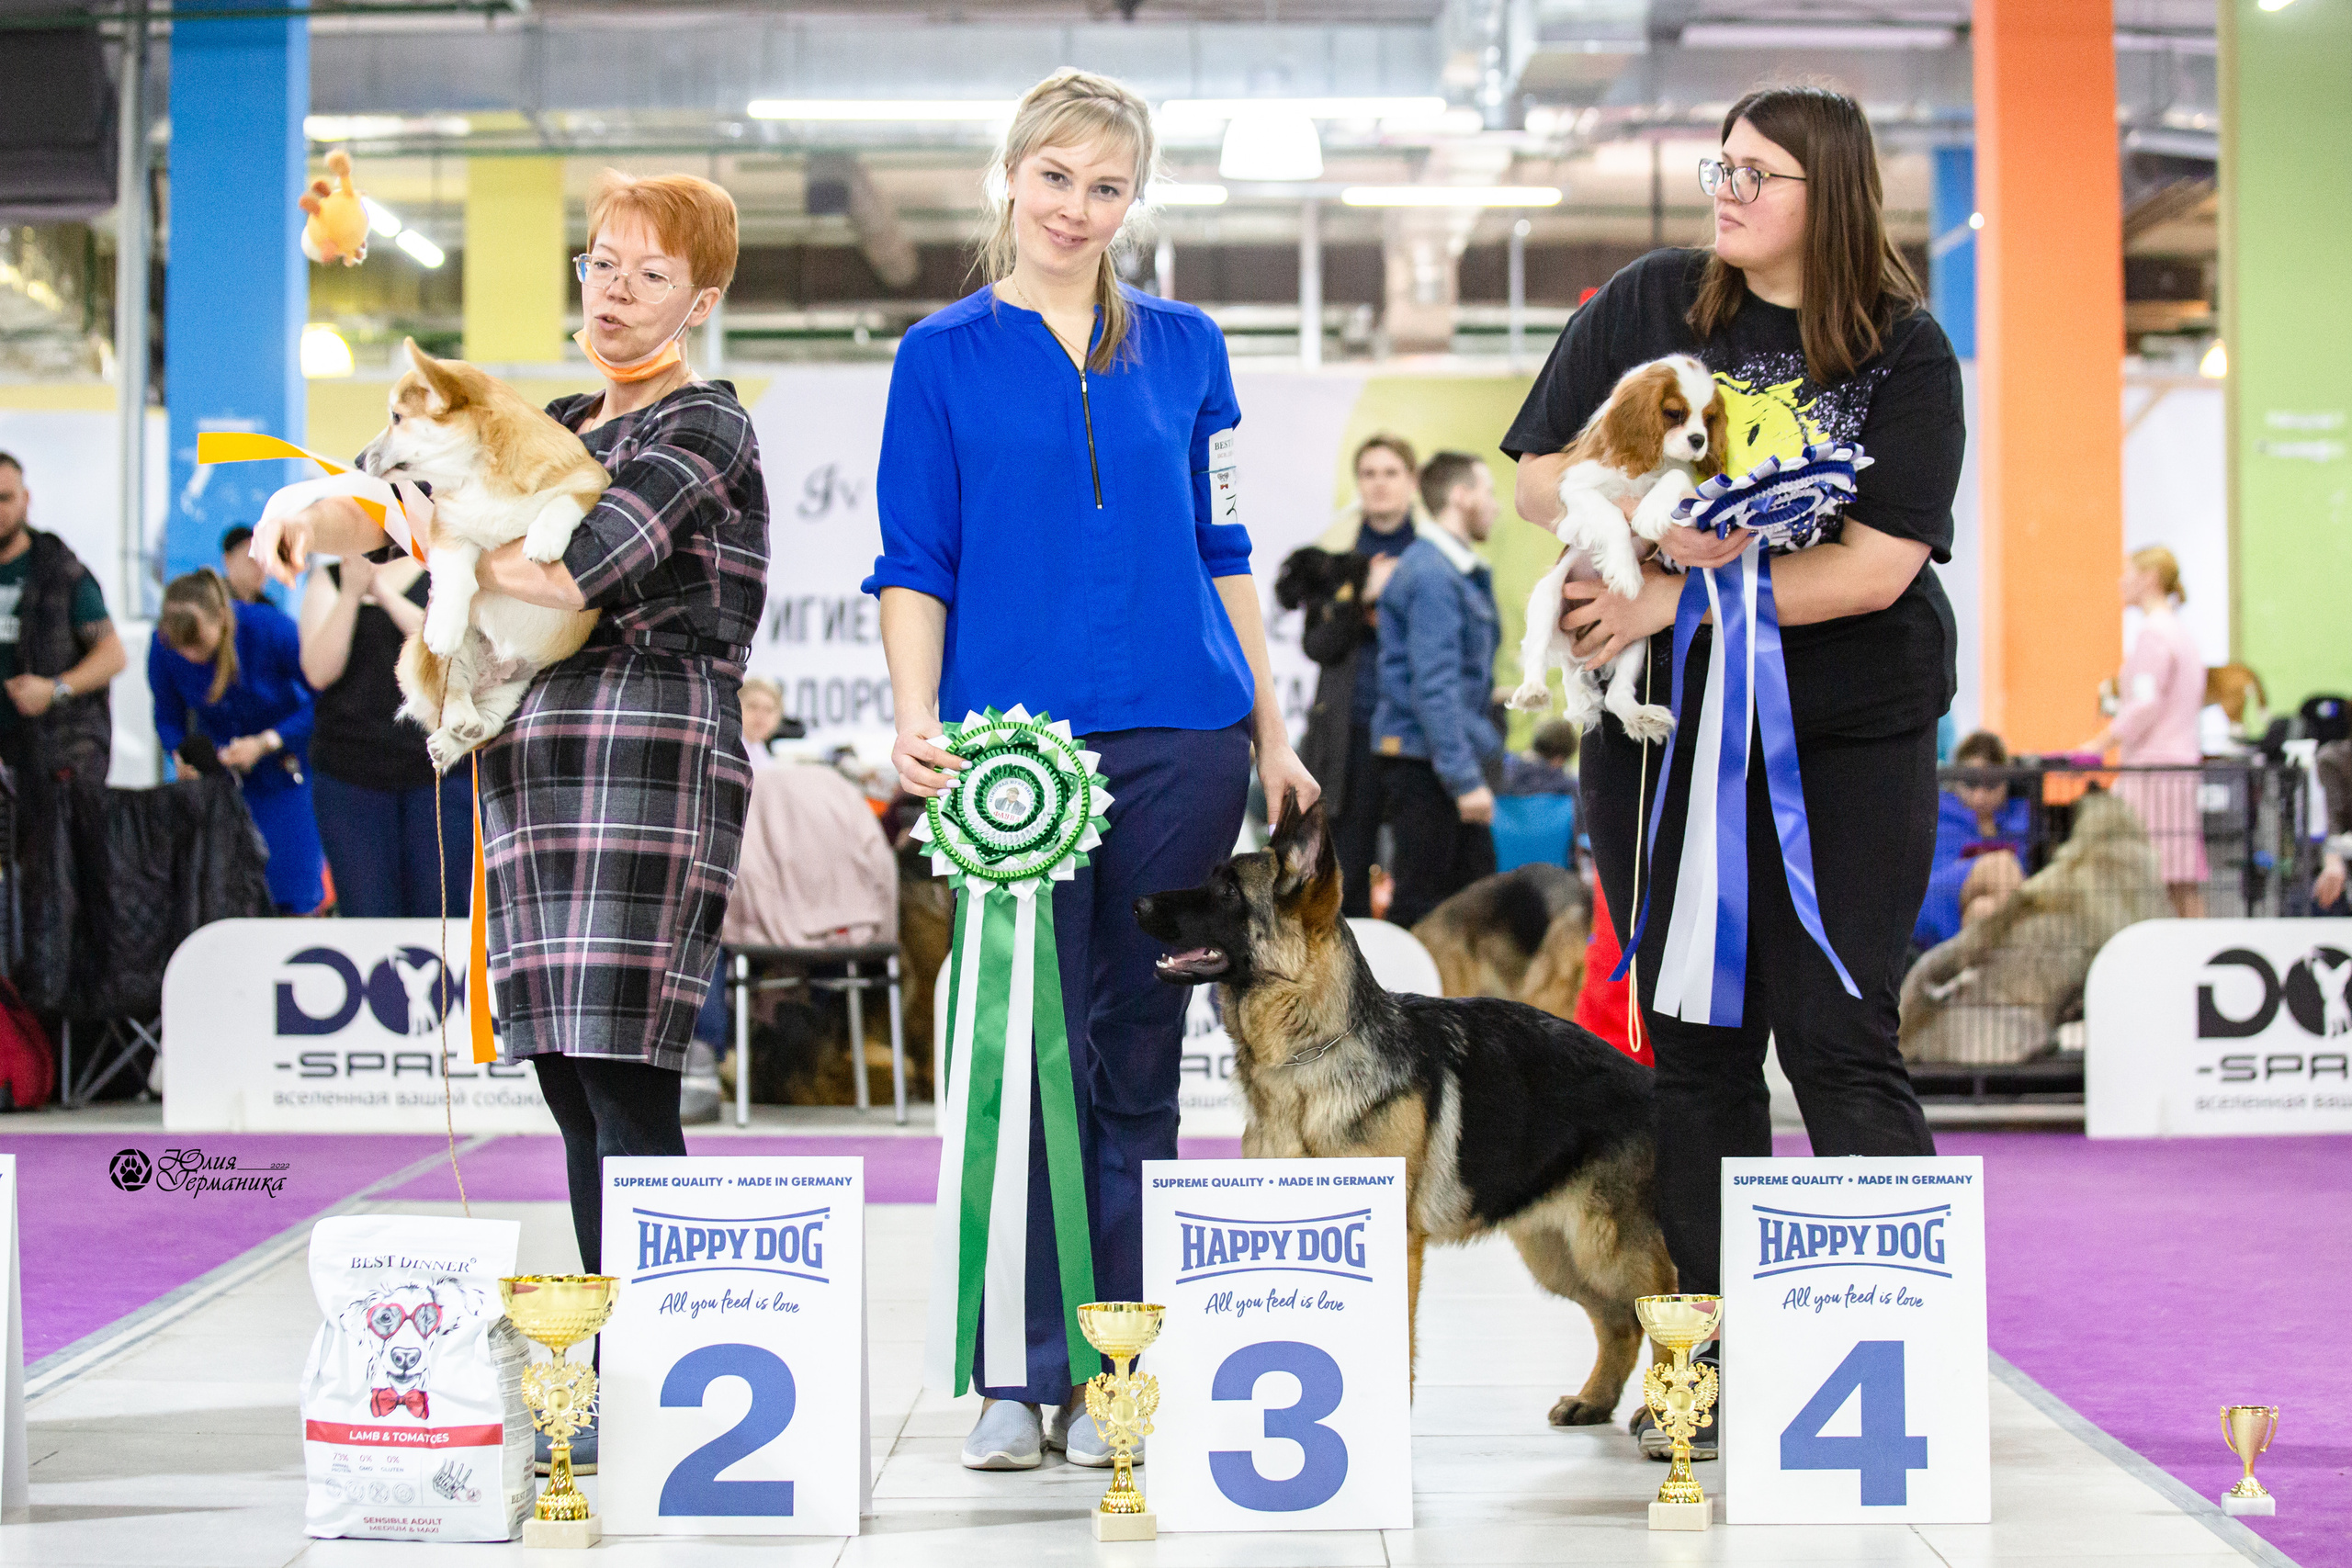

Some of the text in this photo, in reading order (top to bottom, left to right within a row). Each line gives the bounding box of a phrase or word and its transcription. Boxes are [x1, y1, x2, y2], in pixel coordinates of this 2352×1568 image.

[768, 596, 880, 643] ИГИЕ
[781, 677, 896, 728] ДОРО
[993, 810, 1021, 823] ФАУНА
[614, 1177, 853, 1187] SUPREME QUALITY MADE IN GERMANY
[1153, 1176, 1395, 1188] SUPREME QUALITY MADE IN GERMANY
[1734, 1175, 1973, 1185] SUPREME QUALITY MADE IN GERMANY
[638, 1220, 823, 1270] HAPPY DOG
[1181, 1223, 1365, 1271] HAPPY DOG
[1758, 1217, 1945, 1266] HAPPY DOG
[351, 1255, 469, 1273] BEST DINNER
[660, 1289, 799, 1318] All you feed is love
[1204, 1289, 1344, 1317] All you feed is love
[1782, 1284, 1924, 1313] All you feed is love
[349, 1430, 449, 1443] LAMB & TOMATOES
[659, 1343, 796, 1517] 2
[1208, 1340, 1349, 1512] 3
[1780, 1340, 1928, 1506] 4
[363, 1517, 443, 1526] SENSIBLE ADULT
